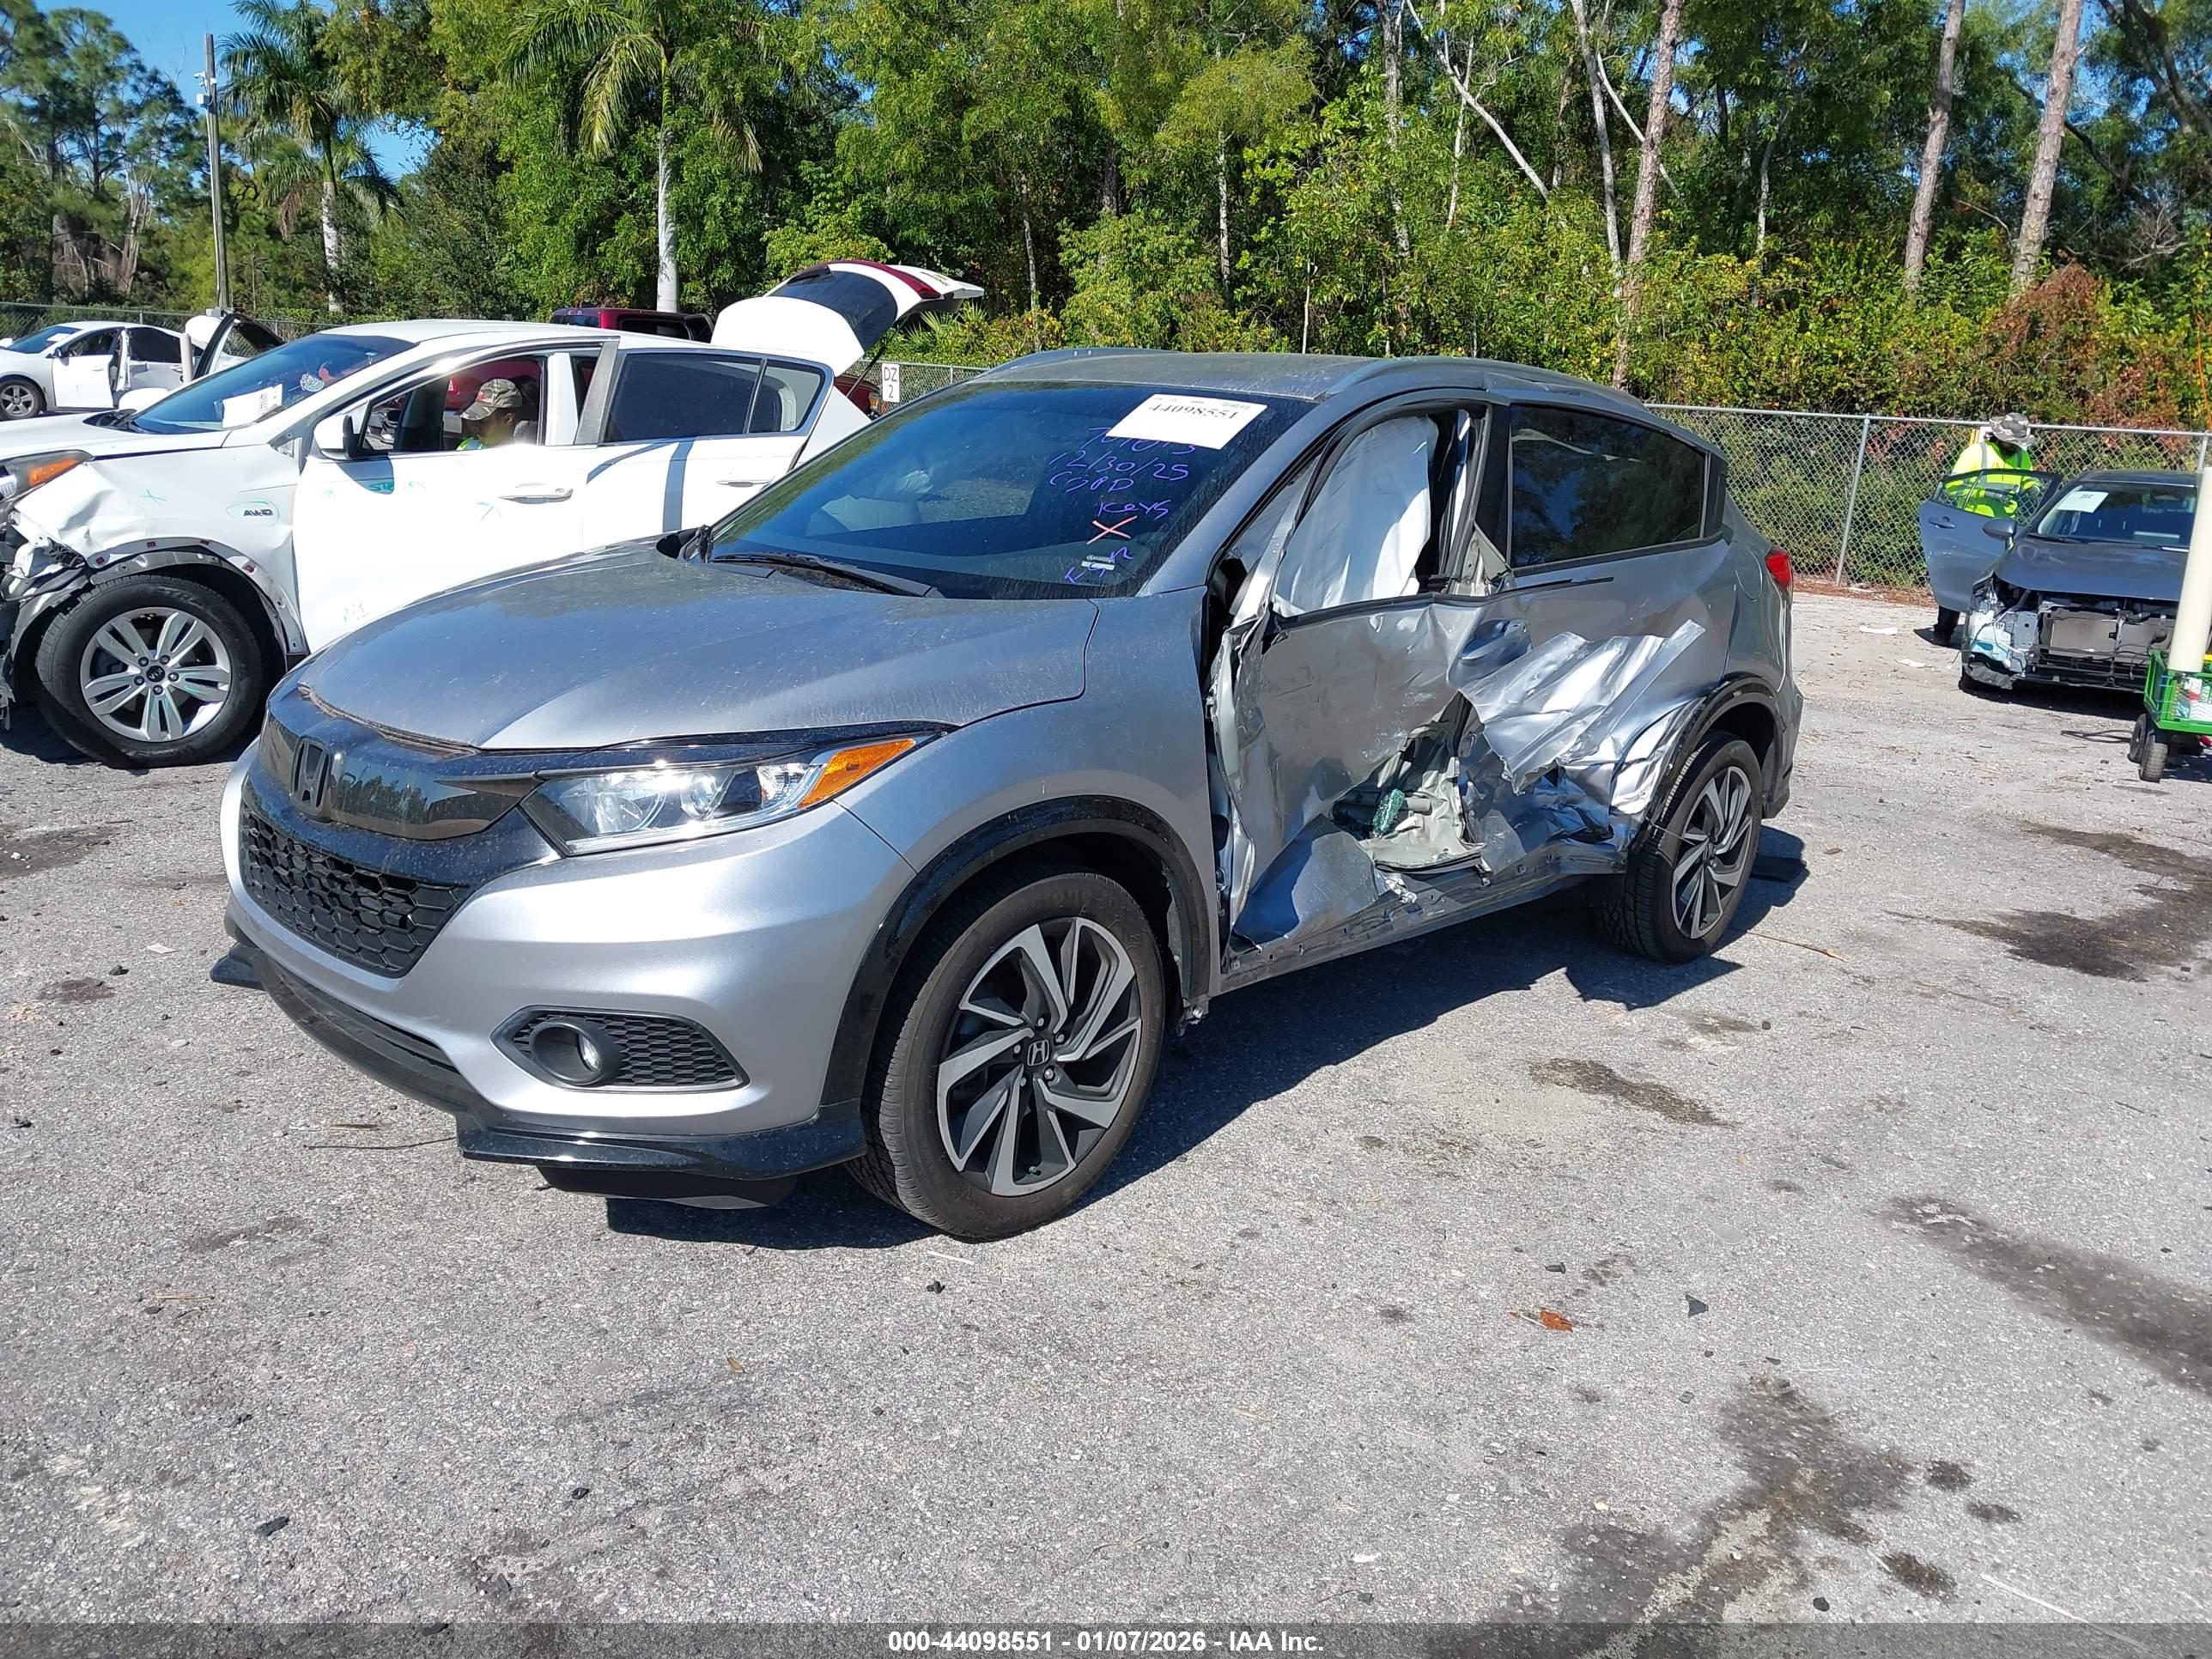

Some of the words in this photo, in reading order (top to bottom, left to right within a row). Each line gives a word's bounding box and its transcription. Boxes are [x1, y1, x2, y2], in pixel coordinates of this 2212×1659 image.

[884, 367, 898, 382] DZ
[888, 384, 894, 398] 2
[1149, 404, 1239, 419] 44098551
[1048, 450, 1189, 482] 12/30/25
[243, 508, 274, 517] AWD
